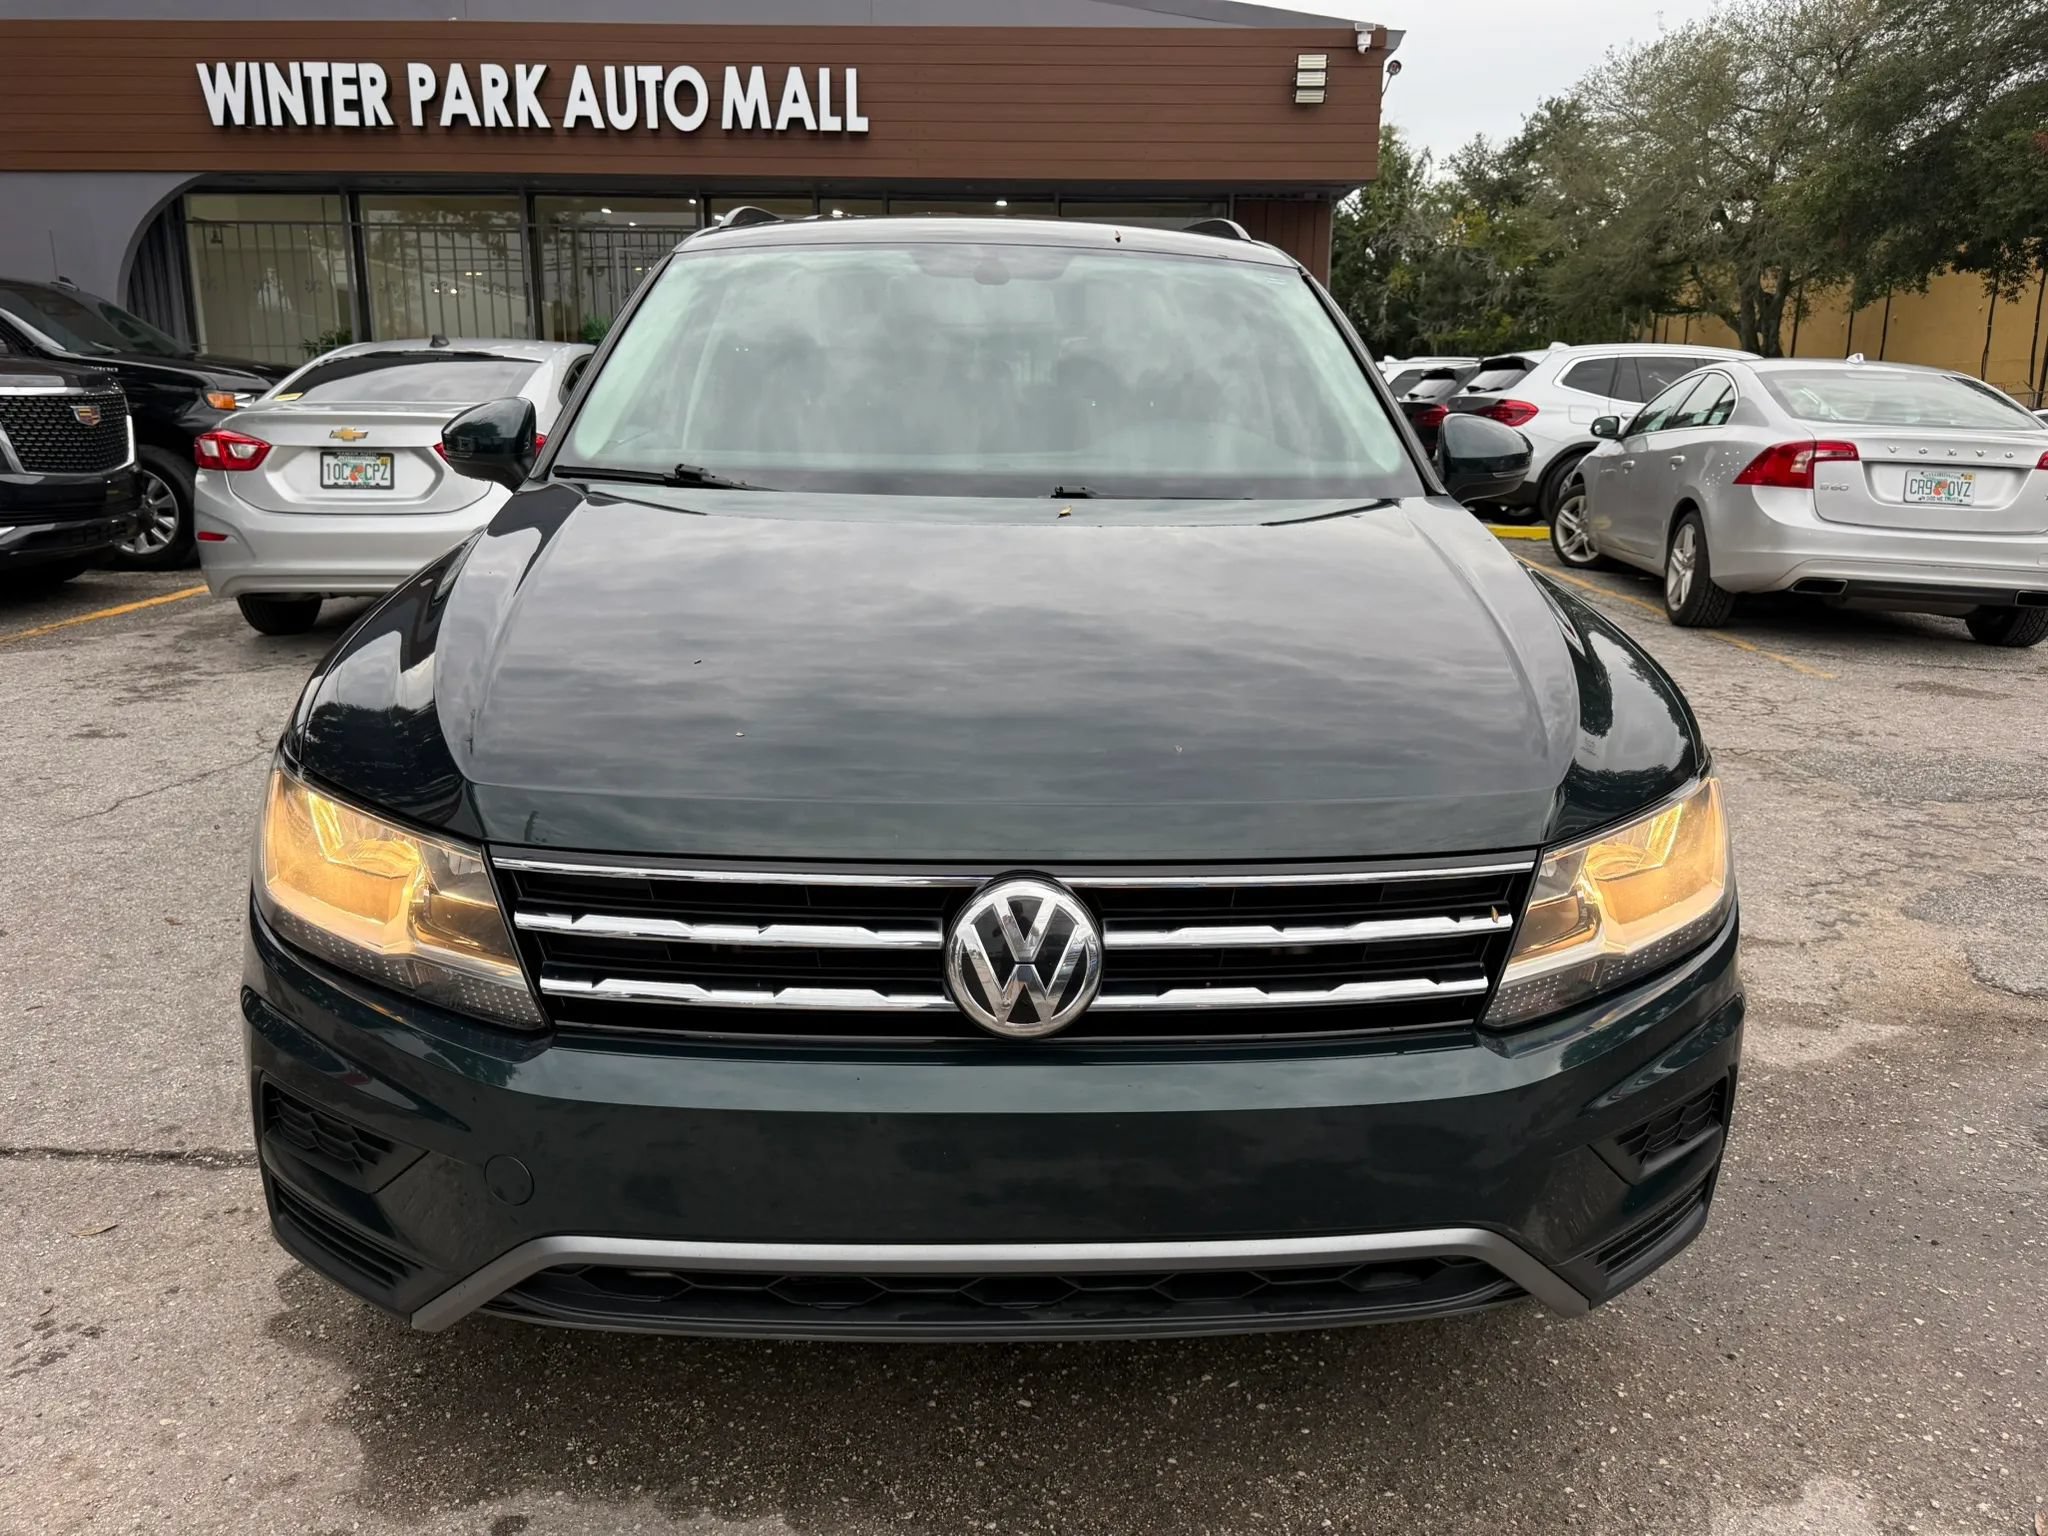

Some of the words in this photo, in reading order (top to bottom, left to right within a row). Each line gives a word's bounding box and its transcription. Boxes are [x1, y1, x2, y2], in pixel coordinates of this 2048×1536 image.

[196, 61, 393, 127] WINTER
[407, 62, 552, 128] PARK
[562, 64, 709, 132] AUTO
[721, 65, 869, 132] MALL
[1887, 445, 2015, 459] VOLVO
